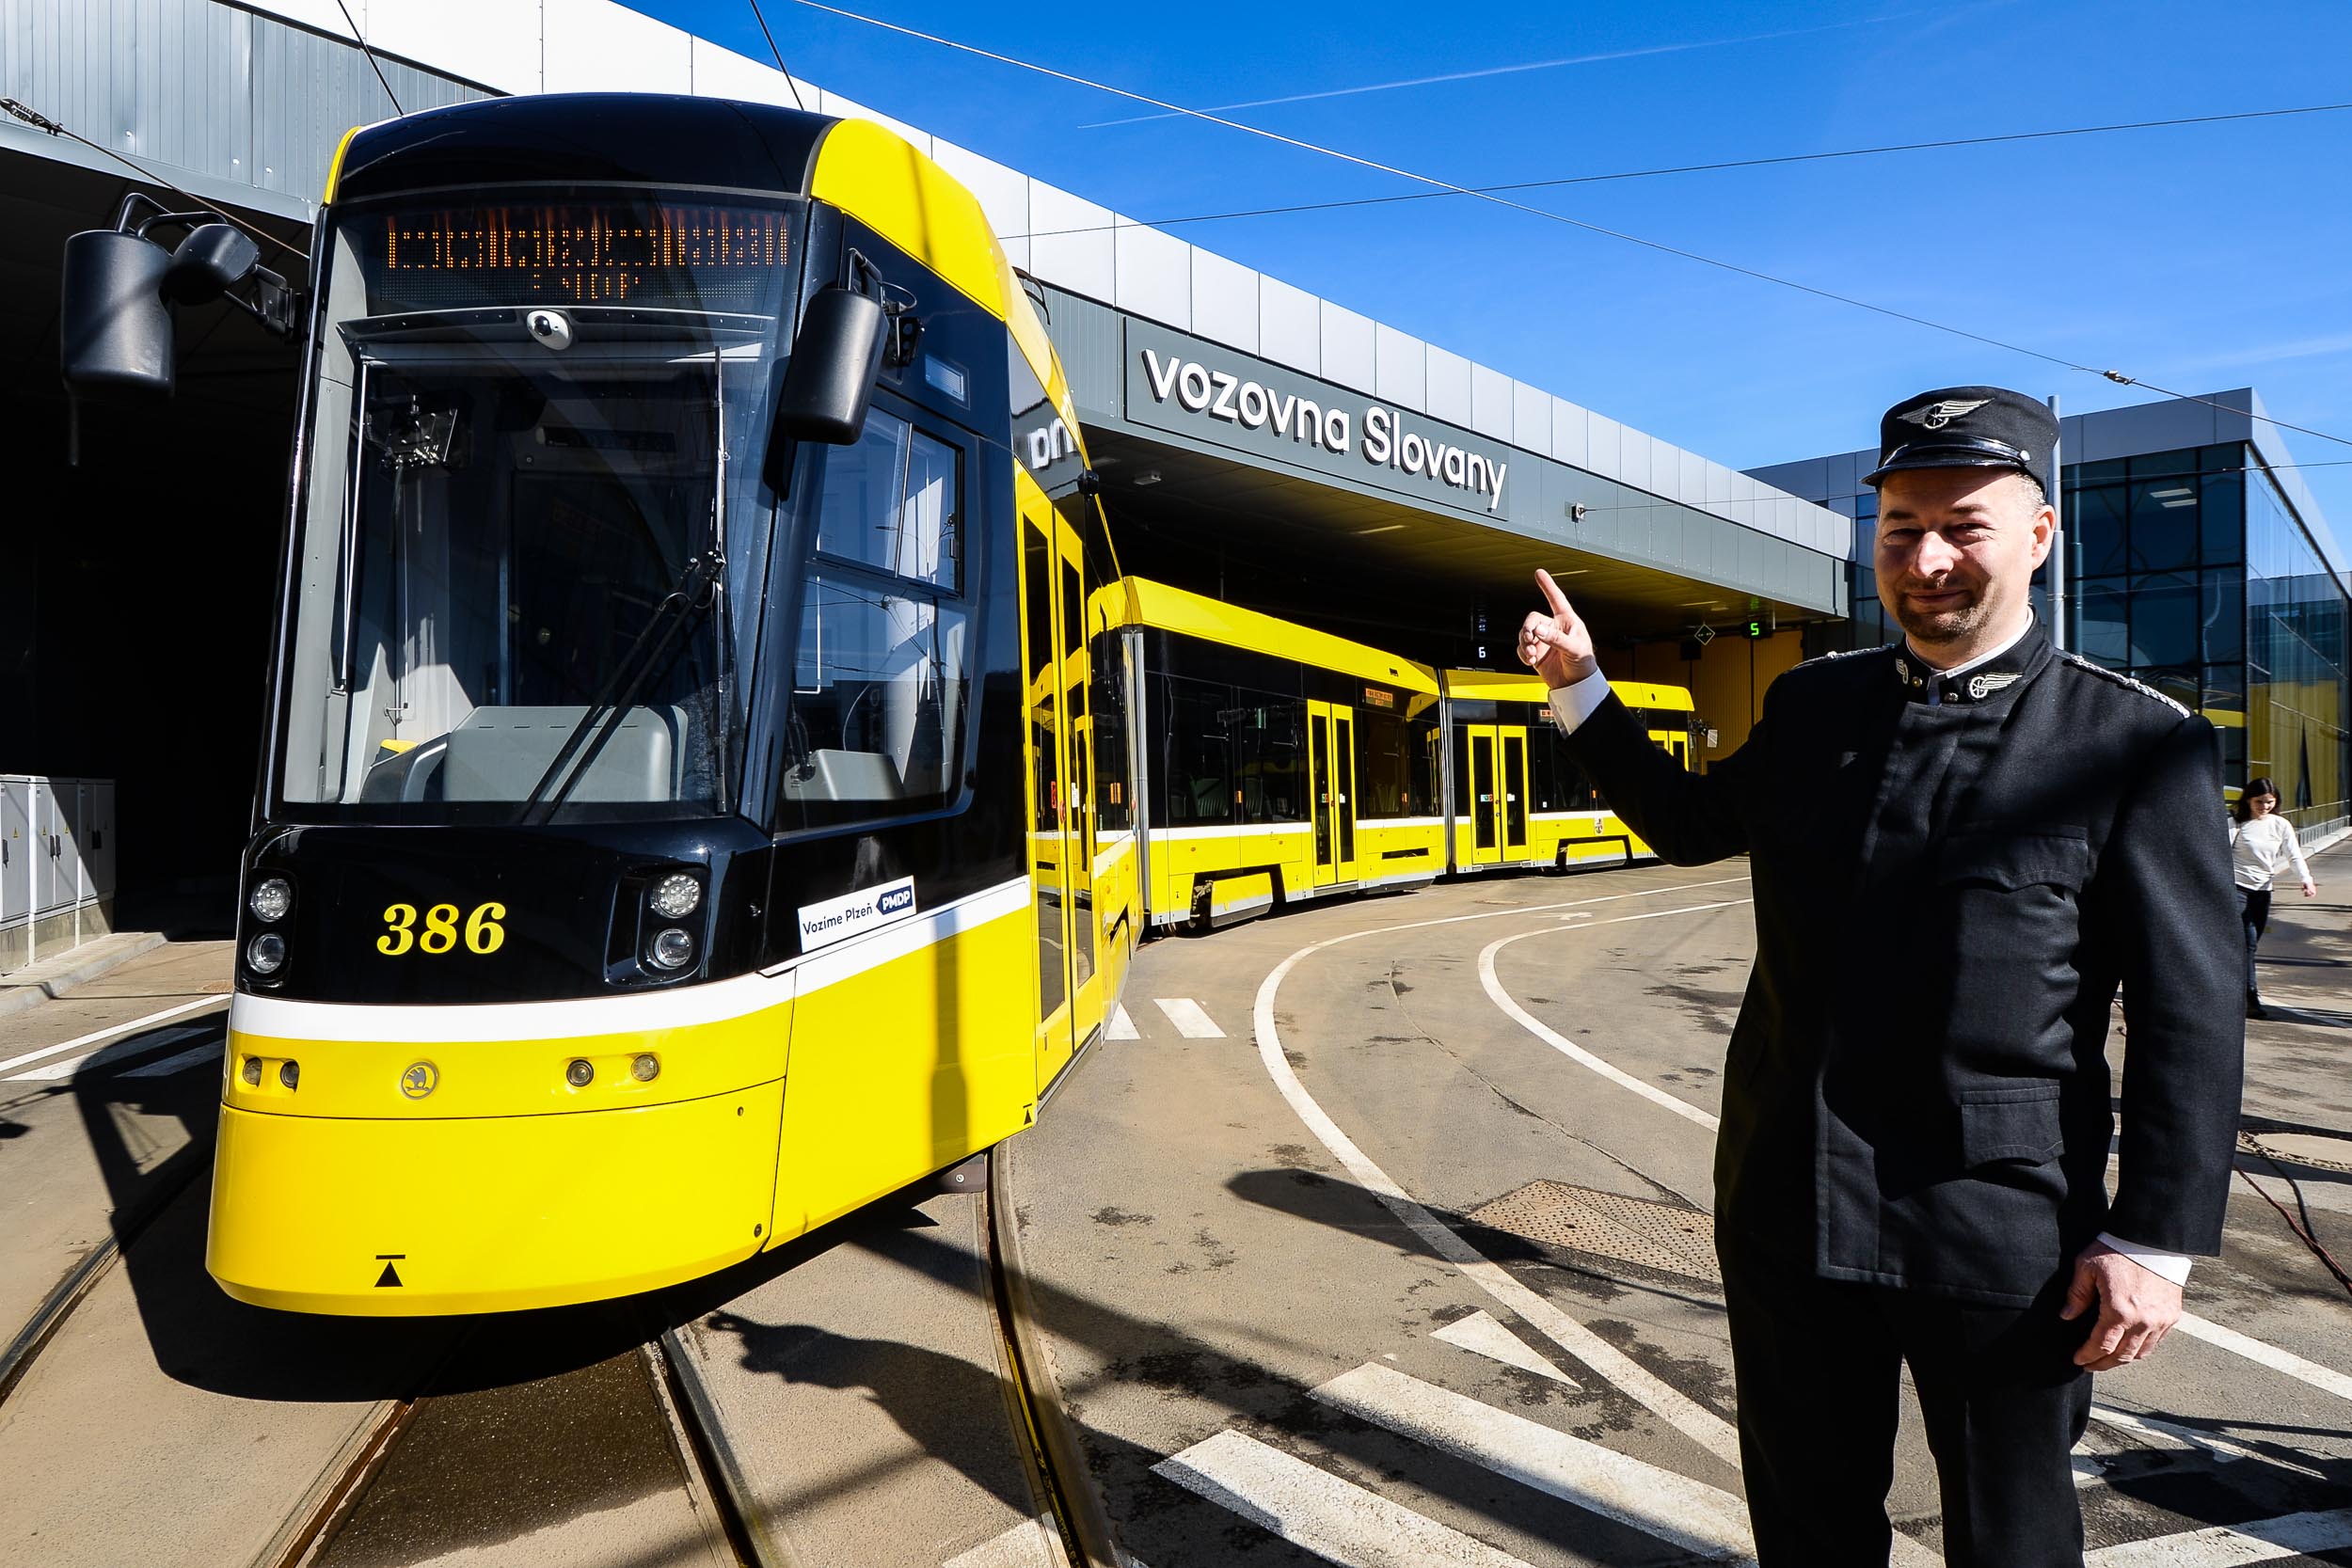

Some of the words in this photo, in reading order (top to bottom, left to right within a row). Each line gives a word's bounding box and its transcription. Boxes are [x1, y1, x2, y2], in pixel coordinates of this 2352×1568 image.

[1141, 348, 1350, 455] vozovna
[1361, 406, 1507, 512] Slovany
[1750, 623, 1759, 636] 5
[1478, 646, 1486, 658] 6
[882, 890, 911, 911] PMDP
[376, 901, 506, 956] 386
[803, 915, 843, 935] Vozíme
[845, 902, 873, 923] Plzeň
